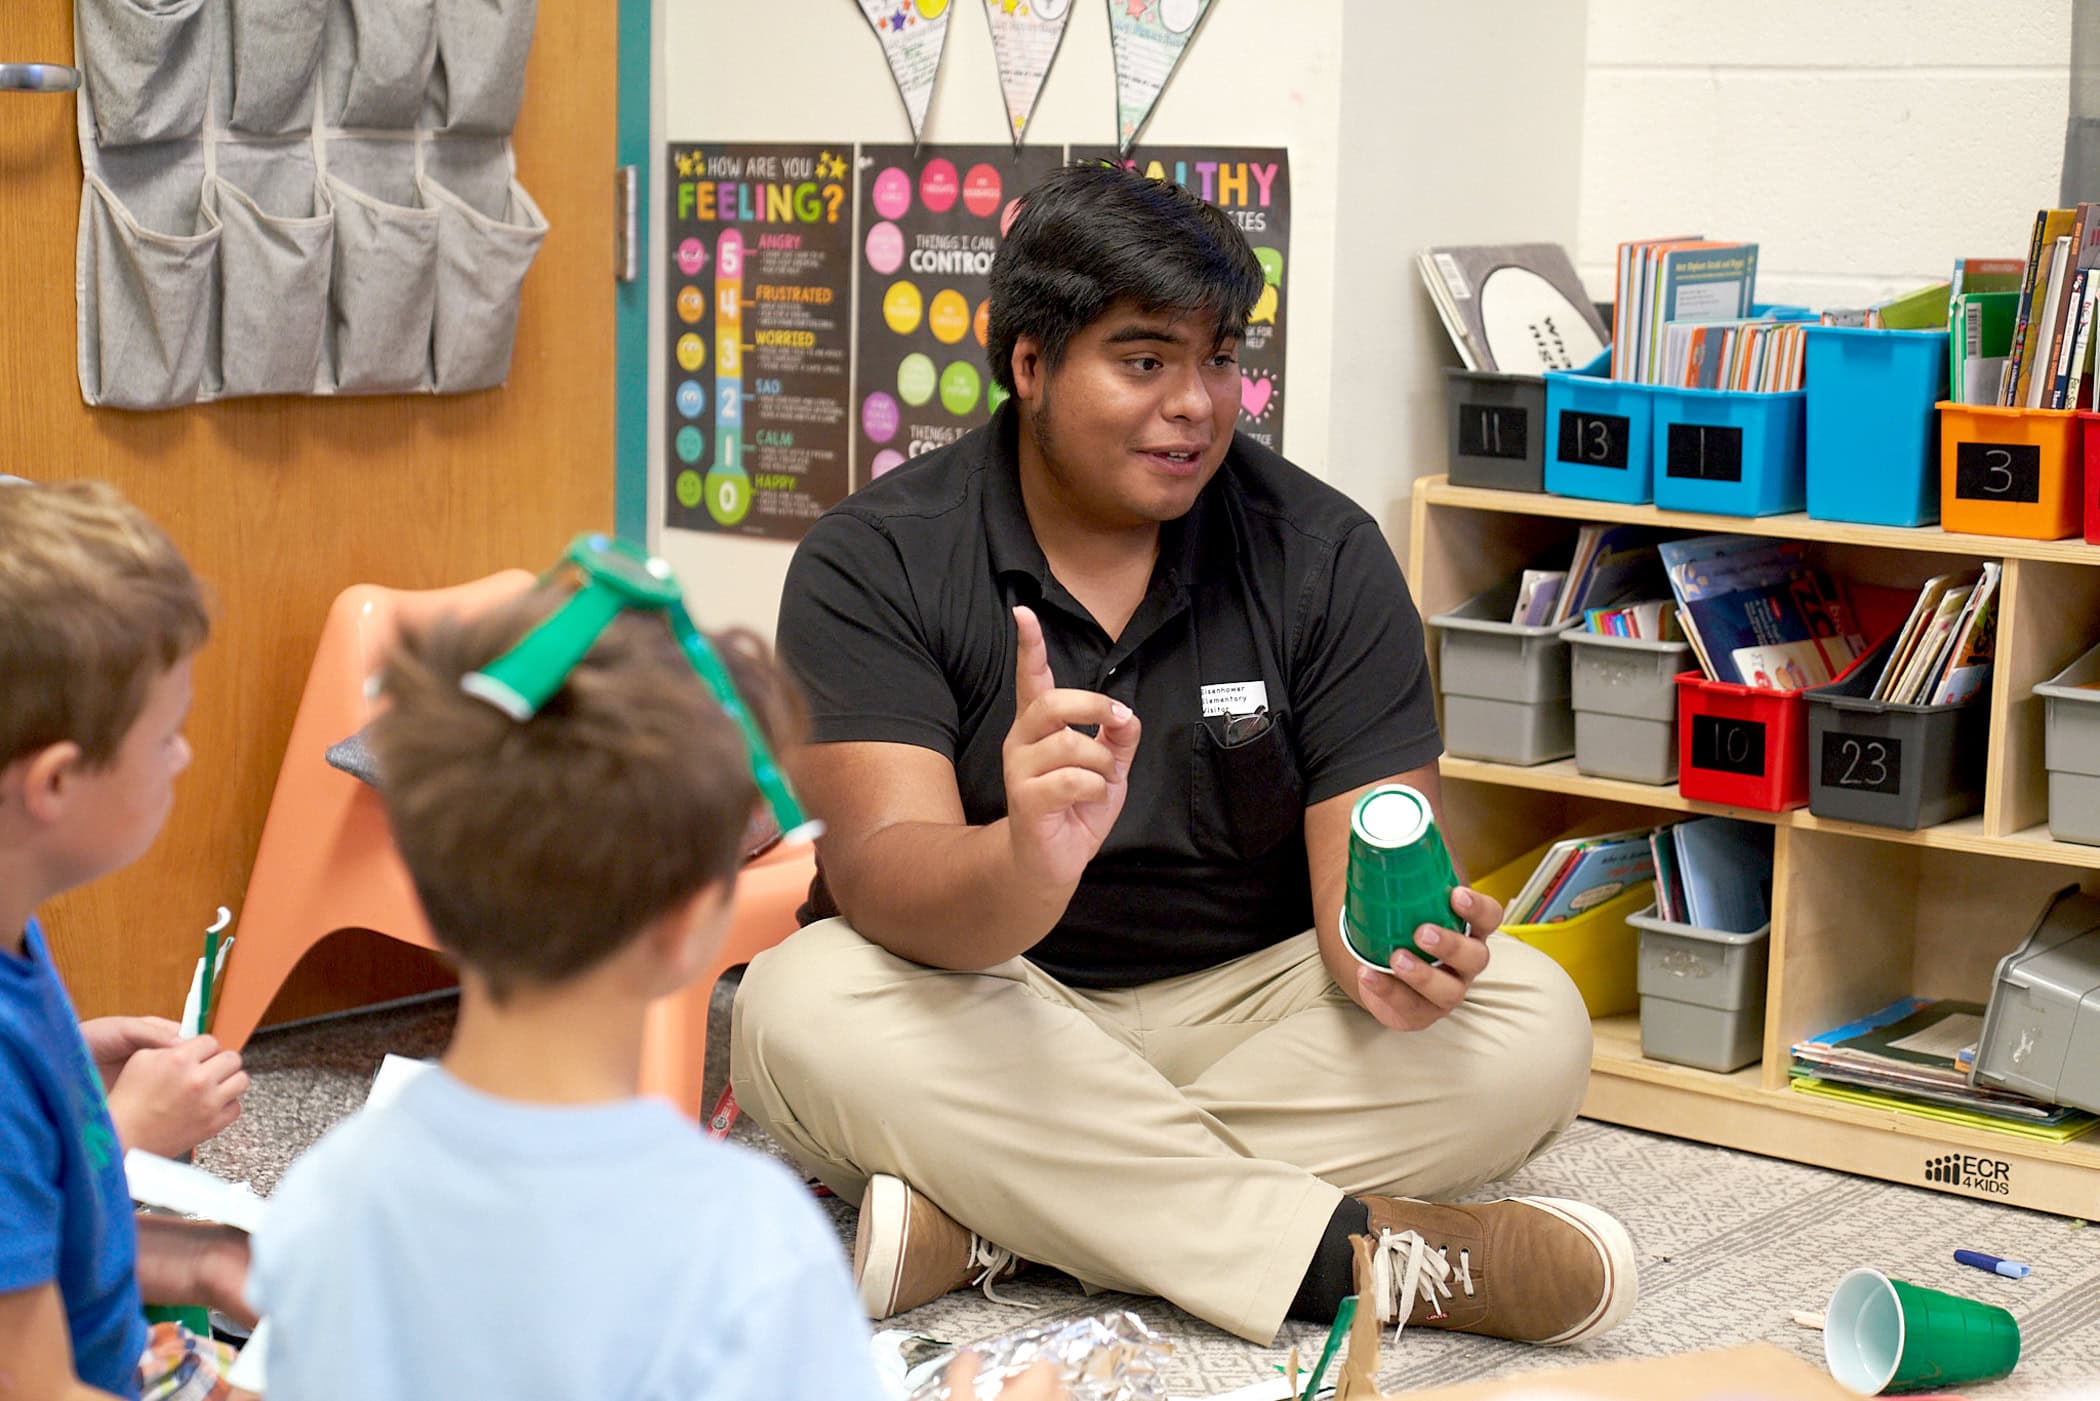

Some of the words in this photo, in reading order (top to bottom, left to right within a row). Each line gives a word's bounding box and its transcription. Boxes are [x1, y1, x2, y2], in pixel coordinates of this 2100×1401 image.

[708, 156, 741, 177] HOW
[746, 157, 777, 179] ARE
[781, 158, 812, 179] YOU
[678, 181, 844, 223] FEELING?
[758, 234, 802, 249] ANGRY
[915, 234, 959, 249] THINGS
[962, 235, 970, 250] I
[721, 242, 739, 274] 5
[909, 249, 996, 274] CONTRO
[720, 288, 737, 319] 4
[755, 285, 833, 304] FRUSTRATED
[755, 330, 815, 347] WORRIED
[720, 338, 736, 369] 3
[755, 379, 782, 394] SAD
[721, 388, 737, 418] 2
[755, 430, 794, 447] CALM
[910, 424, 951, 442] THINGS
[1481, 411, 1500, 453] 11
[1577, 417, 1609, 461] 13
[1699, 427, 1706, 476] 1
[755, 474, 796, 490] HAPPY
[1983, 450, 2013, 493] 3
[719, 481, 737, 512] 0
[1201, 686, 1245, 695] Eisenhower
[1202, 696, 1247, 705] Elementary
[1715, 722, 1749, 763] 10
[1839, 740, 1887, 785] 23
[1963, 1155, 2010, 1181] ECR
[1962, 1176, 1972, 1188] 4
[1974, 1177, 2009, 1195] KIDS
